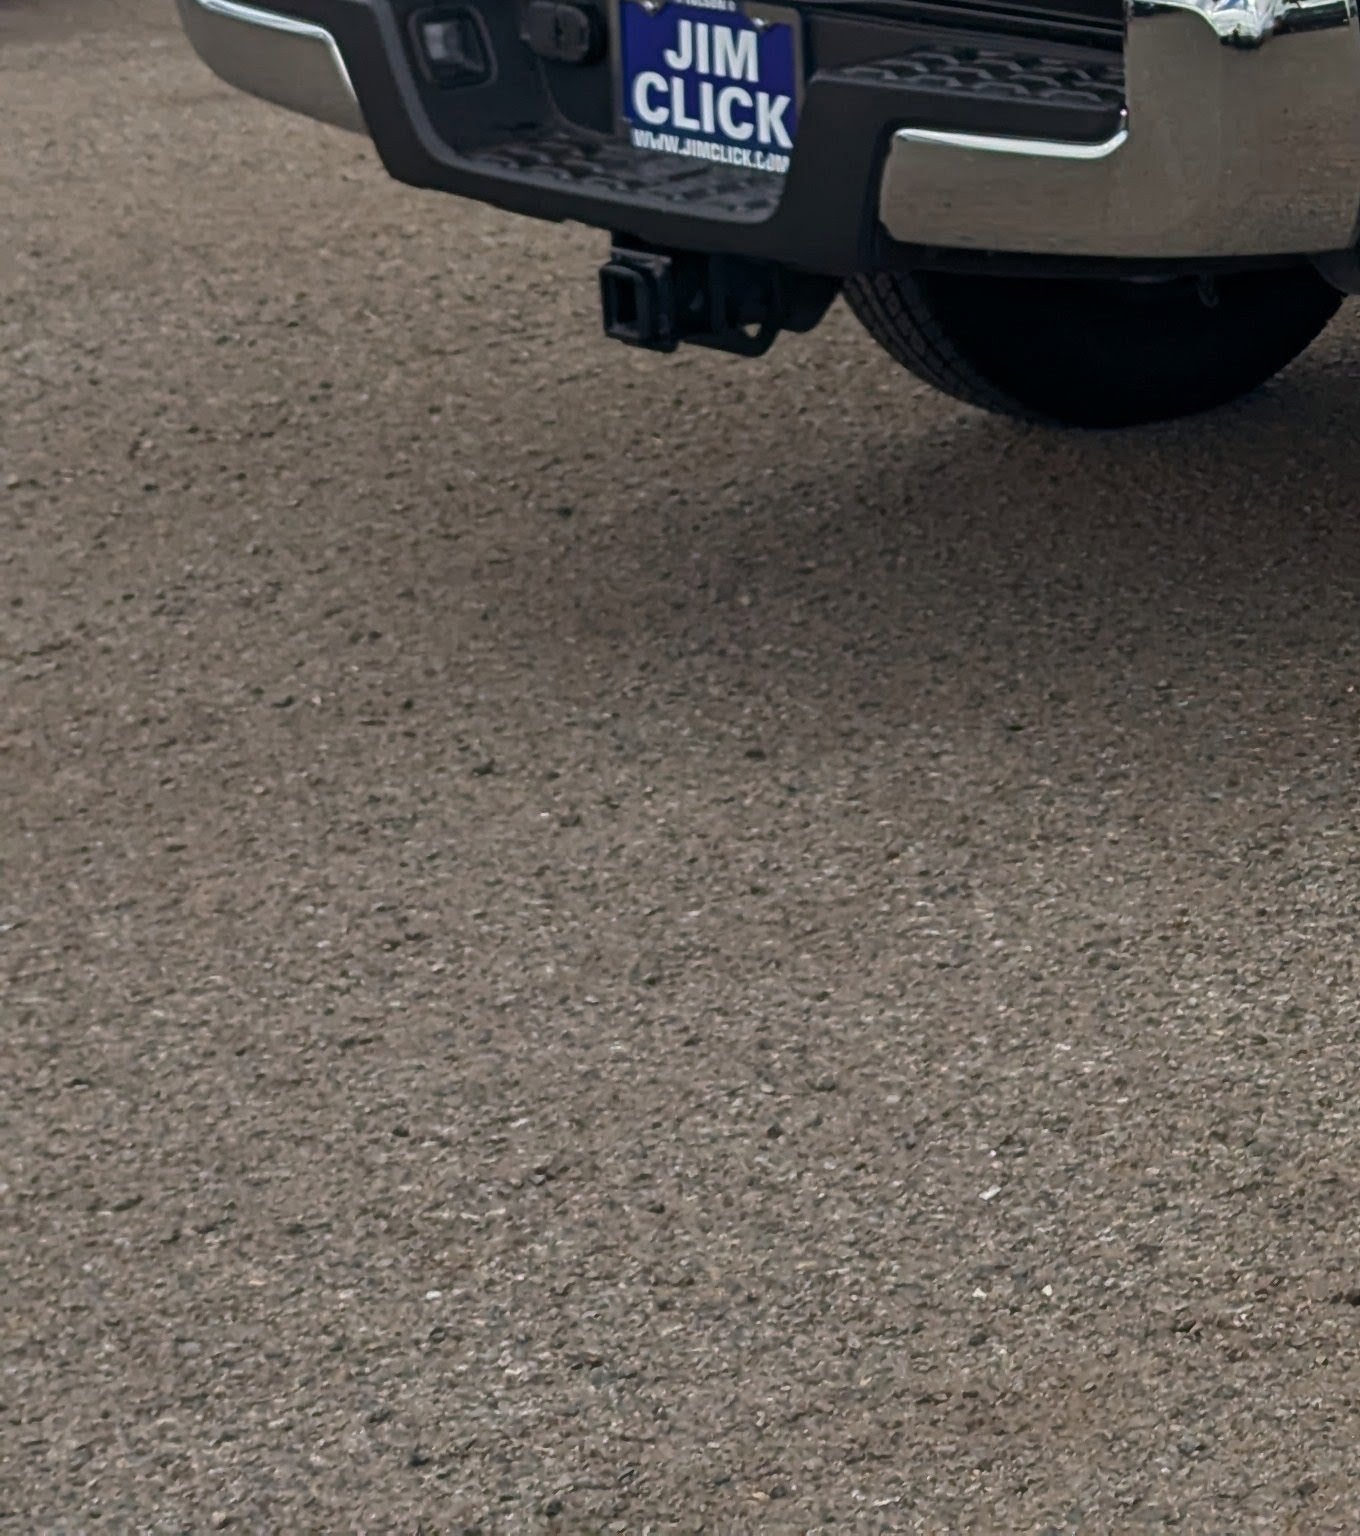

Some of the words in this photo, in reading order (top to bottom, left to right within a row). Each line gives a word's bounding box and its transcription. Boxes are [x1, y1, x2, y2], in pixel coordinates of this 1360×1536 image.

[663, 19, 759, 83] JIM
[633, 71, 794, 149] CLICK
[631, 128, 791, 173] WWW.JIMCLICK.COM
